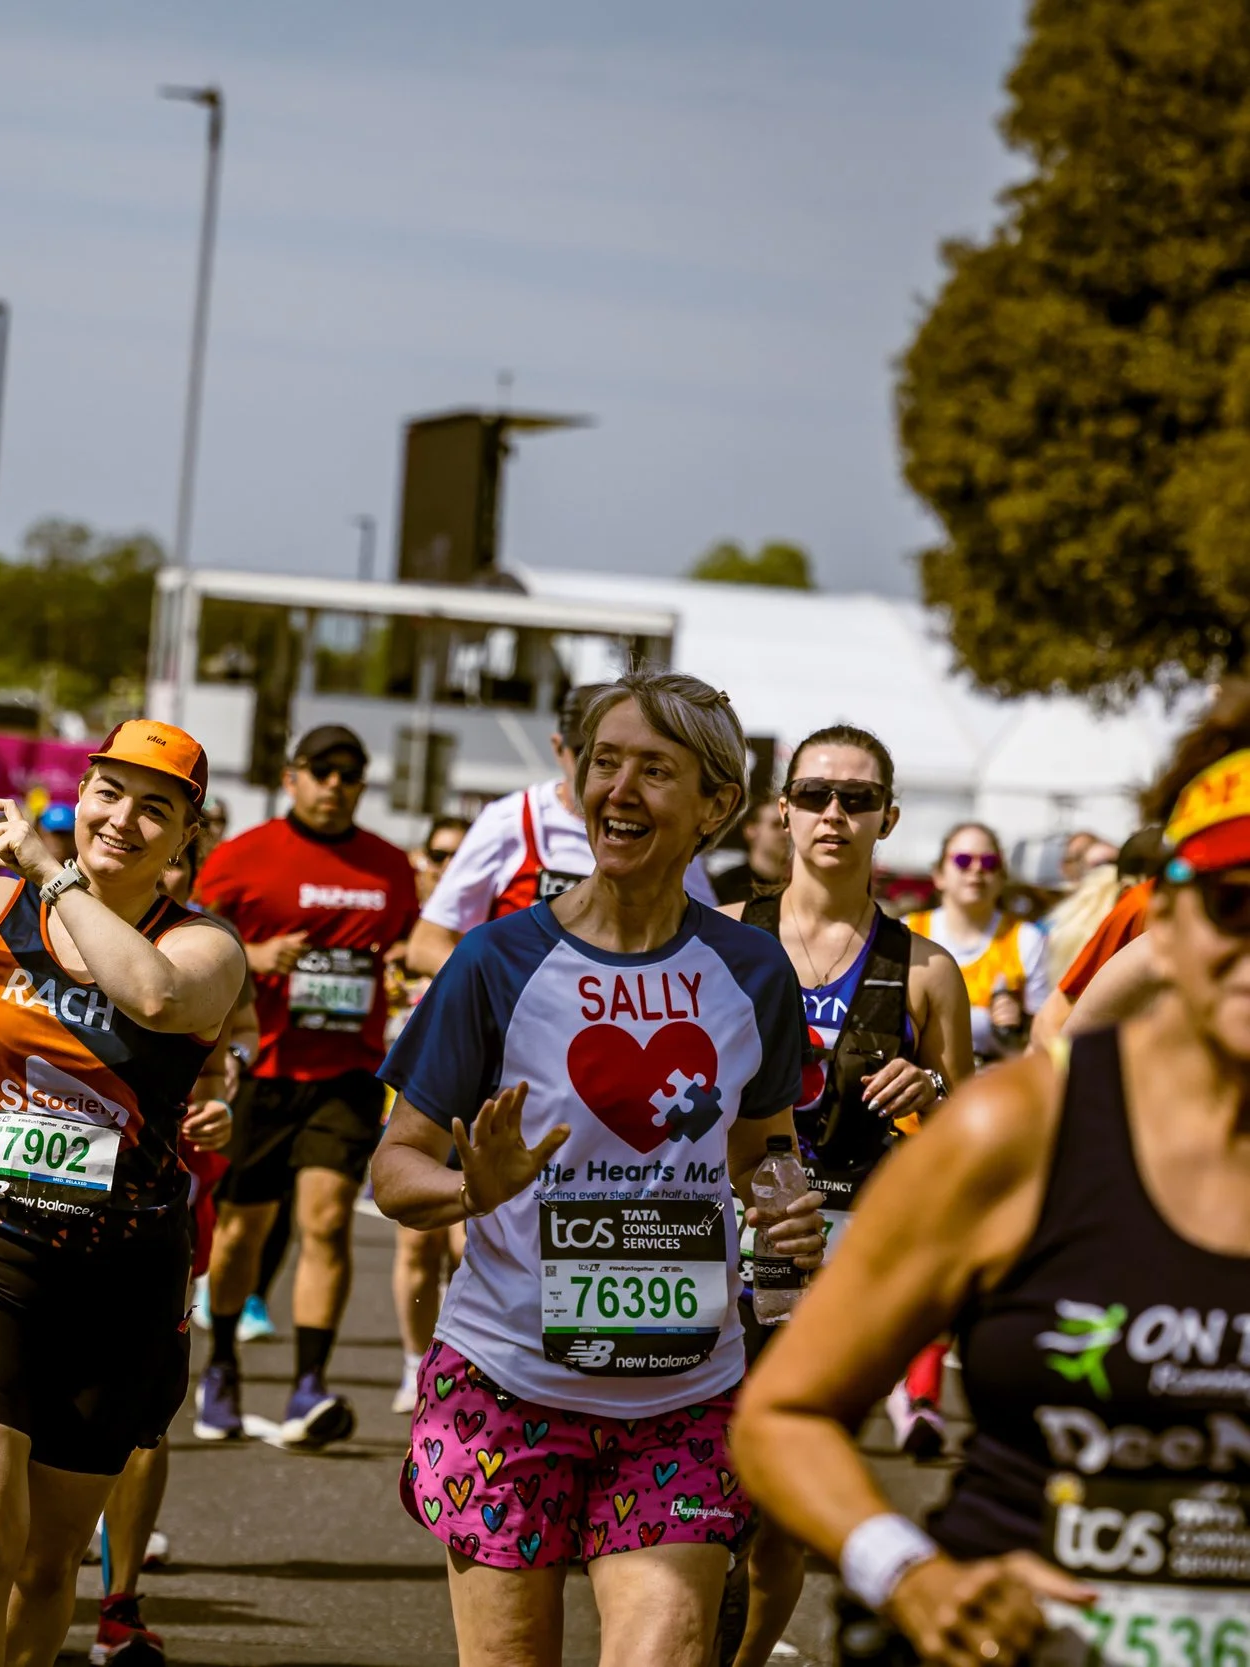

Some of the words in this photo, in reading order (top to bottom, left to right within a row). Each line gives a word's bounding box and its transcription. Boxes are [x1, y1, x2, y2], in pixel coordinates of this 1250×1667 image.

[0, 968, 116, 1032] RACH
[578, 971, 703, 1022] SALLY
[802, 994, 849, 1022] YN
[31, 1089, 121, 1122] Socie
[586, 1159, 676, 1183] Hearts
[806, 1180, 853, 1193] SULTANCY
[36, 1197, 91, 1216] balance
[550, 1210, 616, 1249] tcs
[621, 1209, 661, 1222] TATA
[621, 1223, 713, 1236] CONSULTANCY
[622, 1237, 681, 1250] SERVICES
[570, 1276, 698, 1319] 76396
[1126, 1304, 1228, 1366] ON
[616, 1356, 648, 1369] new
[649, 1353, 701, 1369] balance
[1054, 1502, 1165, 1576] tcs
